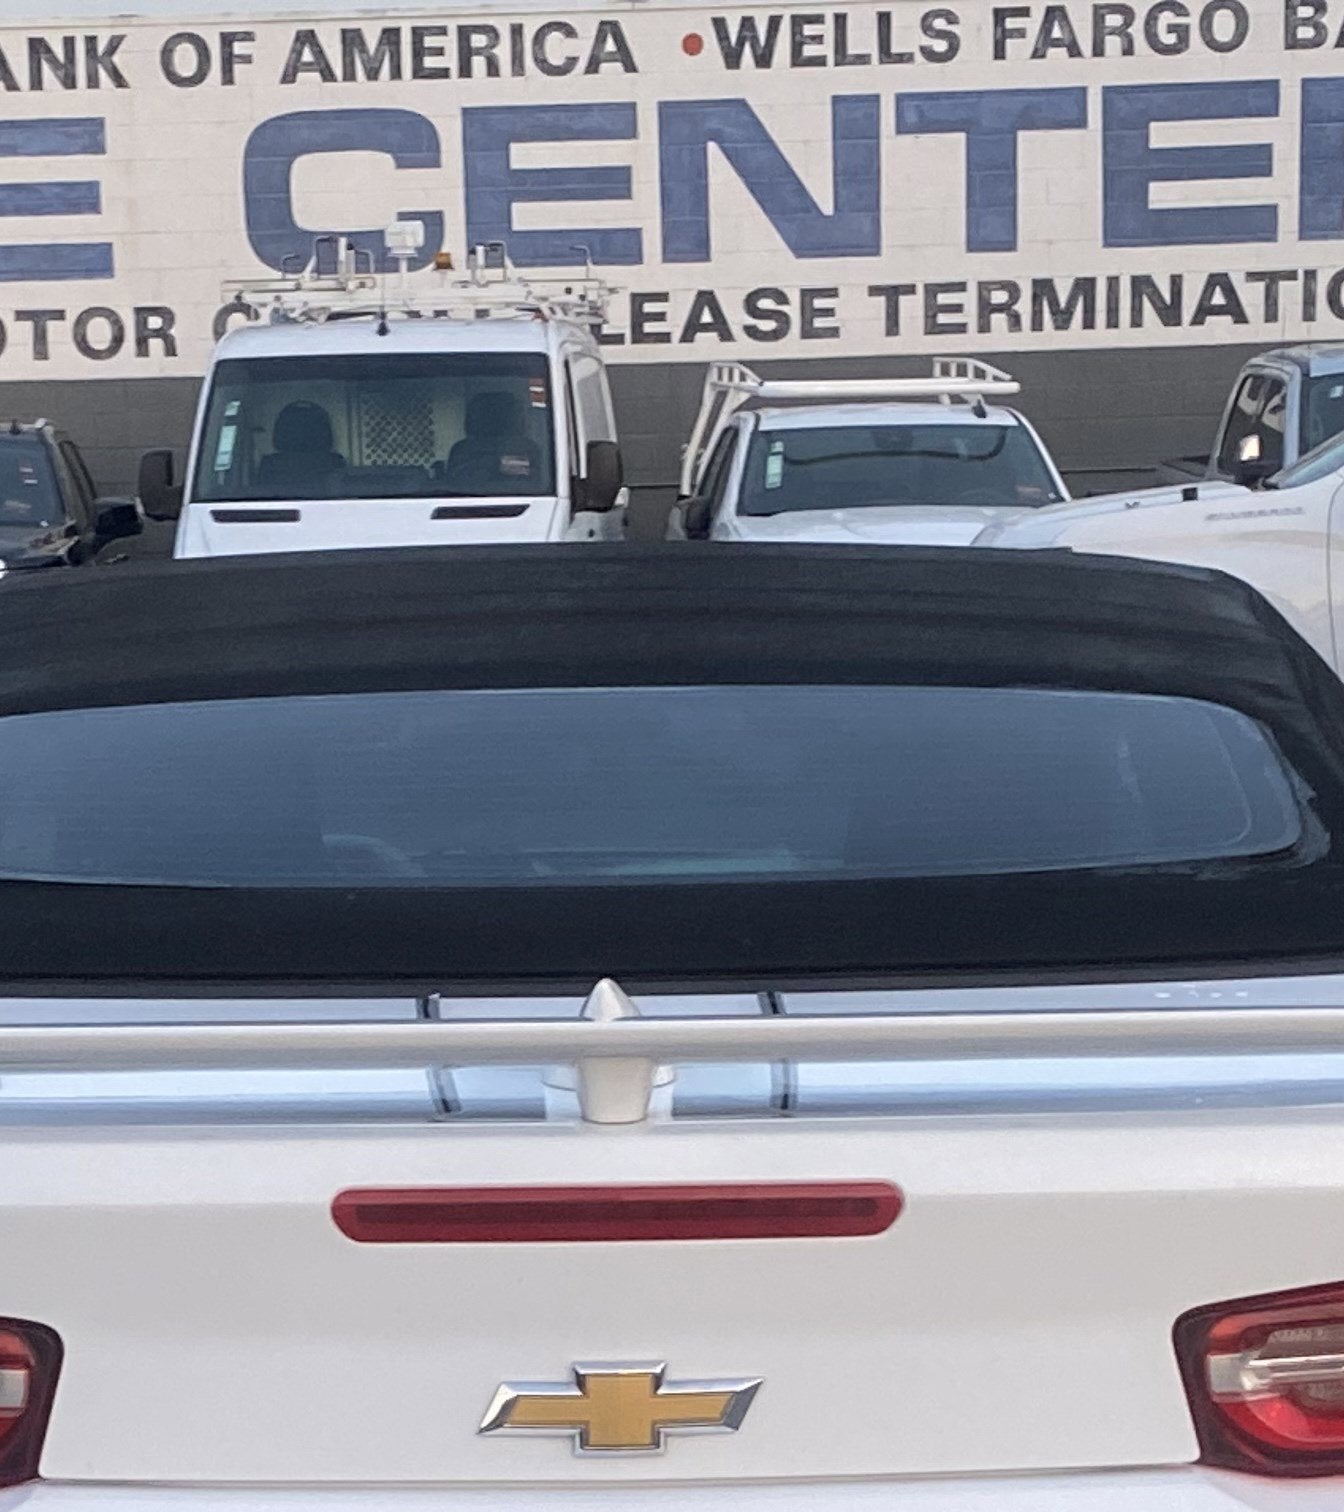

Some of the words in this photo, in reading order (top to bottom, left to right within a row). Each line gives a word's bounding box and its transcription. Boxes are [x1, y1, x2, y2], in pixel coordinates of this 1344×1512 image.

[159, 30, 256, 88] OF
[279, 19, 638, 85] AMERICA
[711, 8, 962, 70] WELLS
[991, 0, 1250, 60] FARGO
